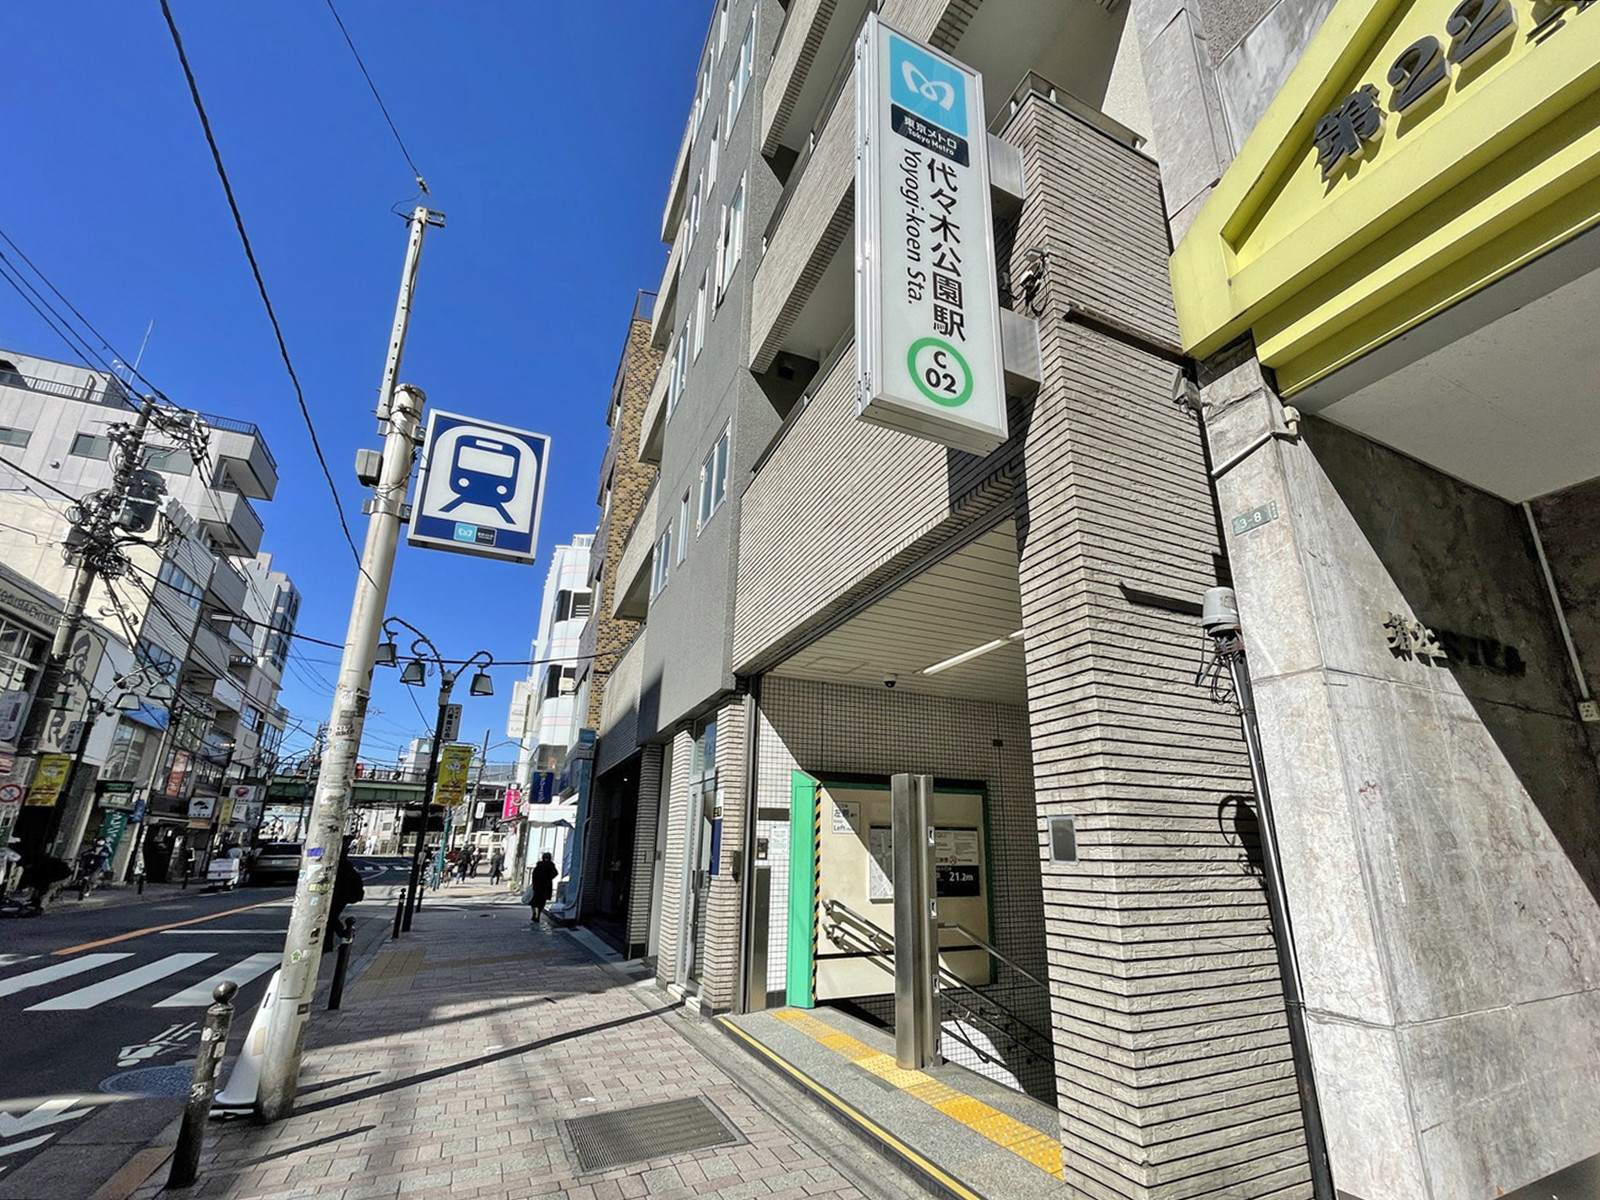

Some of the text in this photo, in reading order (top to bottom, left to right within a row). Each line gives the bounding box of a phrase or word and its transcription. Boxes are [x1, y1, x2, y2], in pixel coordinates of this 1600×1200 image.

[903, 116, 957, 150] 東京メトロ
[907, 127, 955, 156] Tokyo Metro
[899, 147, 926, 304] Yoyogi-koen Sta.
[926, 157, 966, 342] 代々木公園駅
[933, 350, 947, 369] C
[925, 367, 958, 395] 02
[1239, 511, 1262, 529] 3-8
[949, 871, 974, 882] 21.2m
